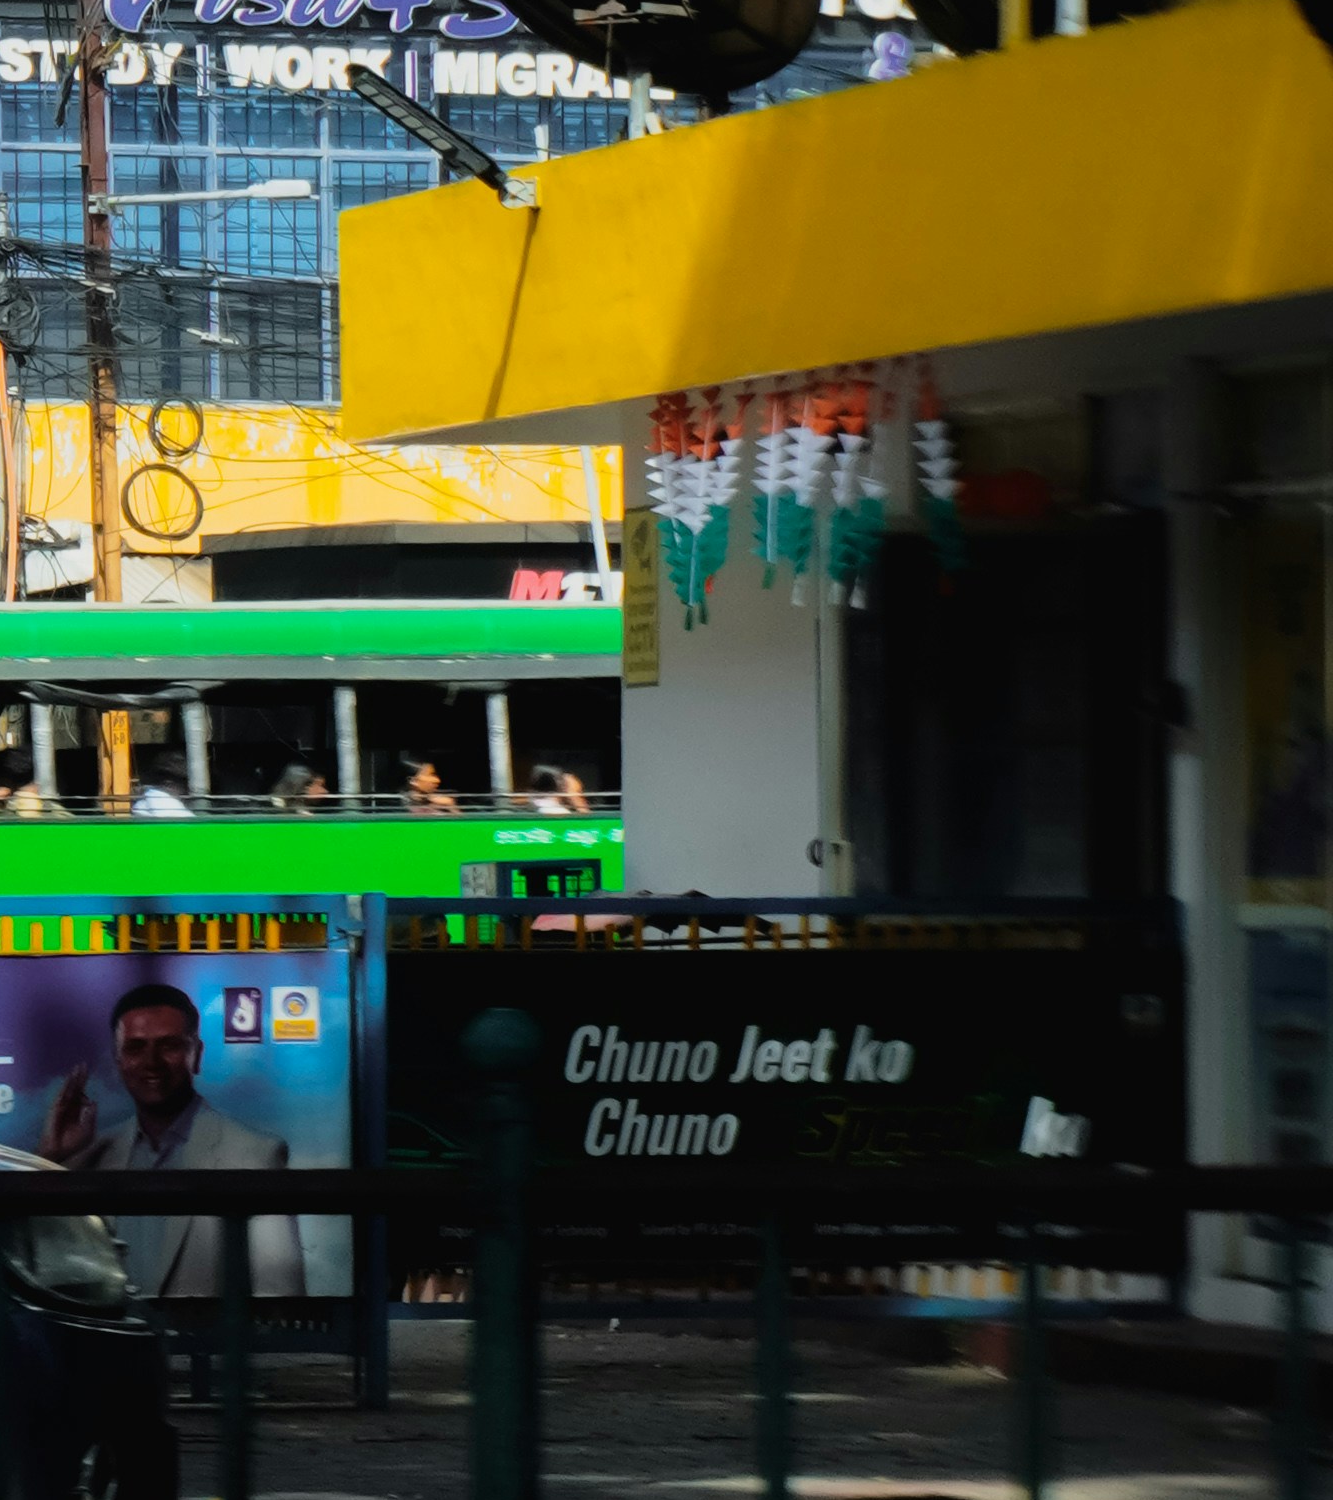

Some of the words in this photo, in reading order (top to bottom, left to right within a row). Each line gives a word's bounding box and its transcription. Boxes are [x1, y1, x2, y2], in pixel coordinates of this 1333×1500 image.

[225, 43, 392, 92] WORK
[564, 1023, 721, 1085] Chuno
[727, 1022, 836, 1085] Jeet
[843, 1022, 917, 1085] ko
[583, 1097, 741, 1159] Chuno
